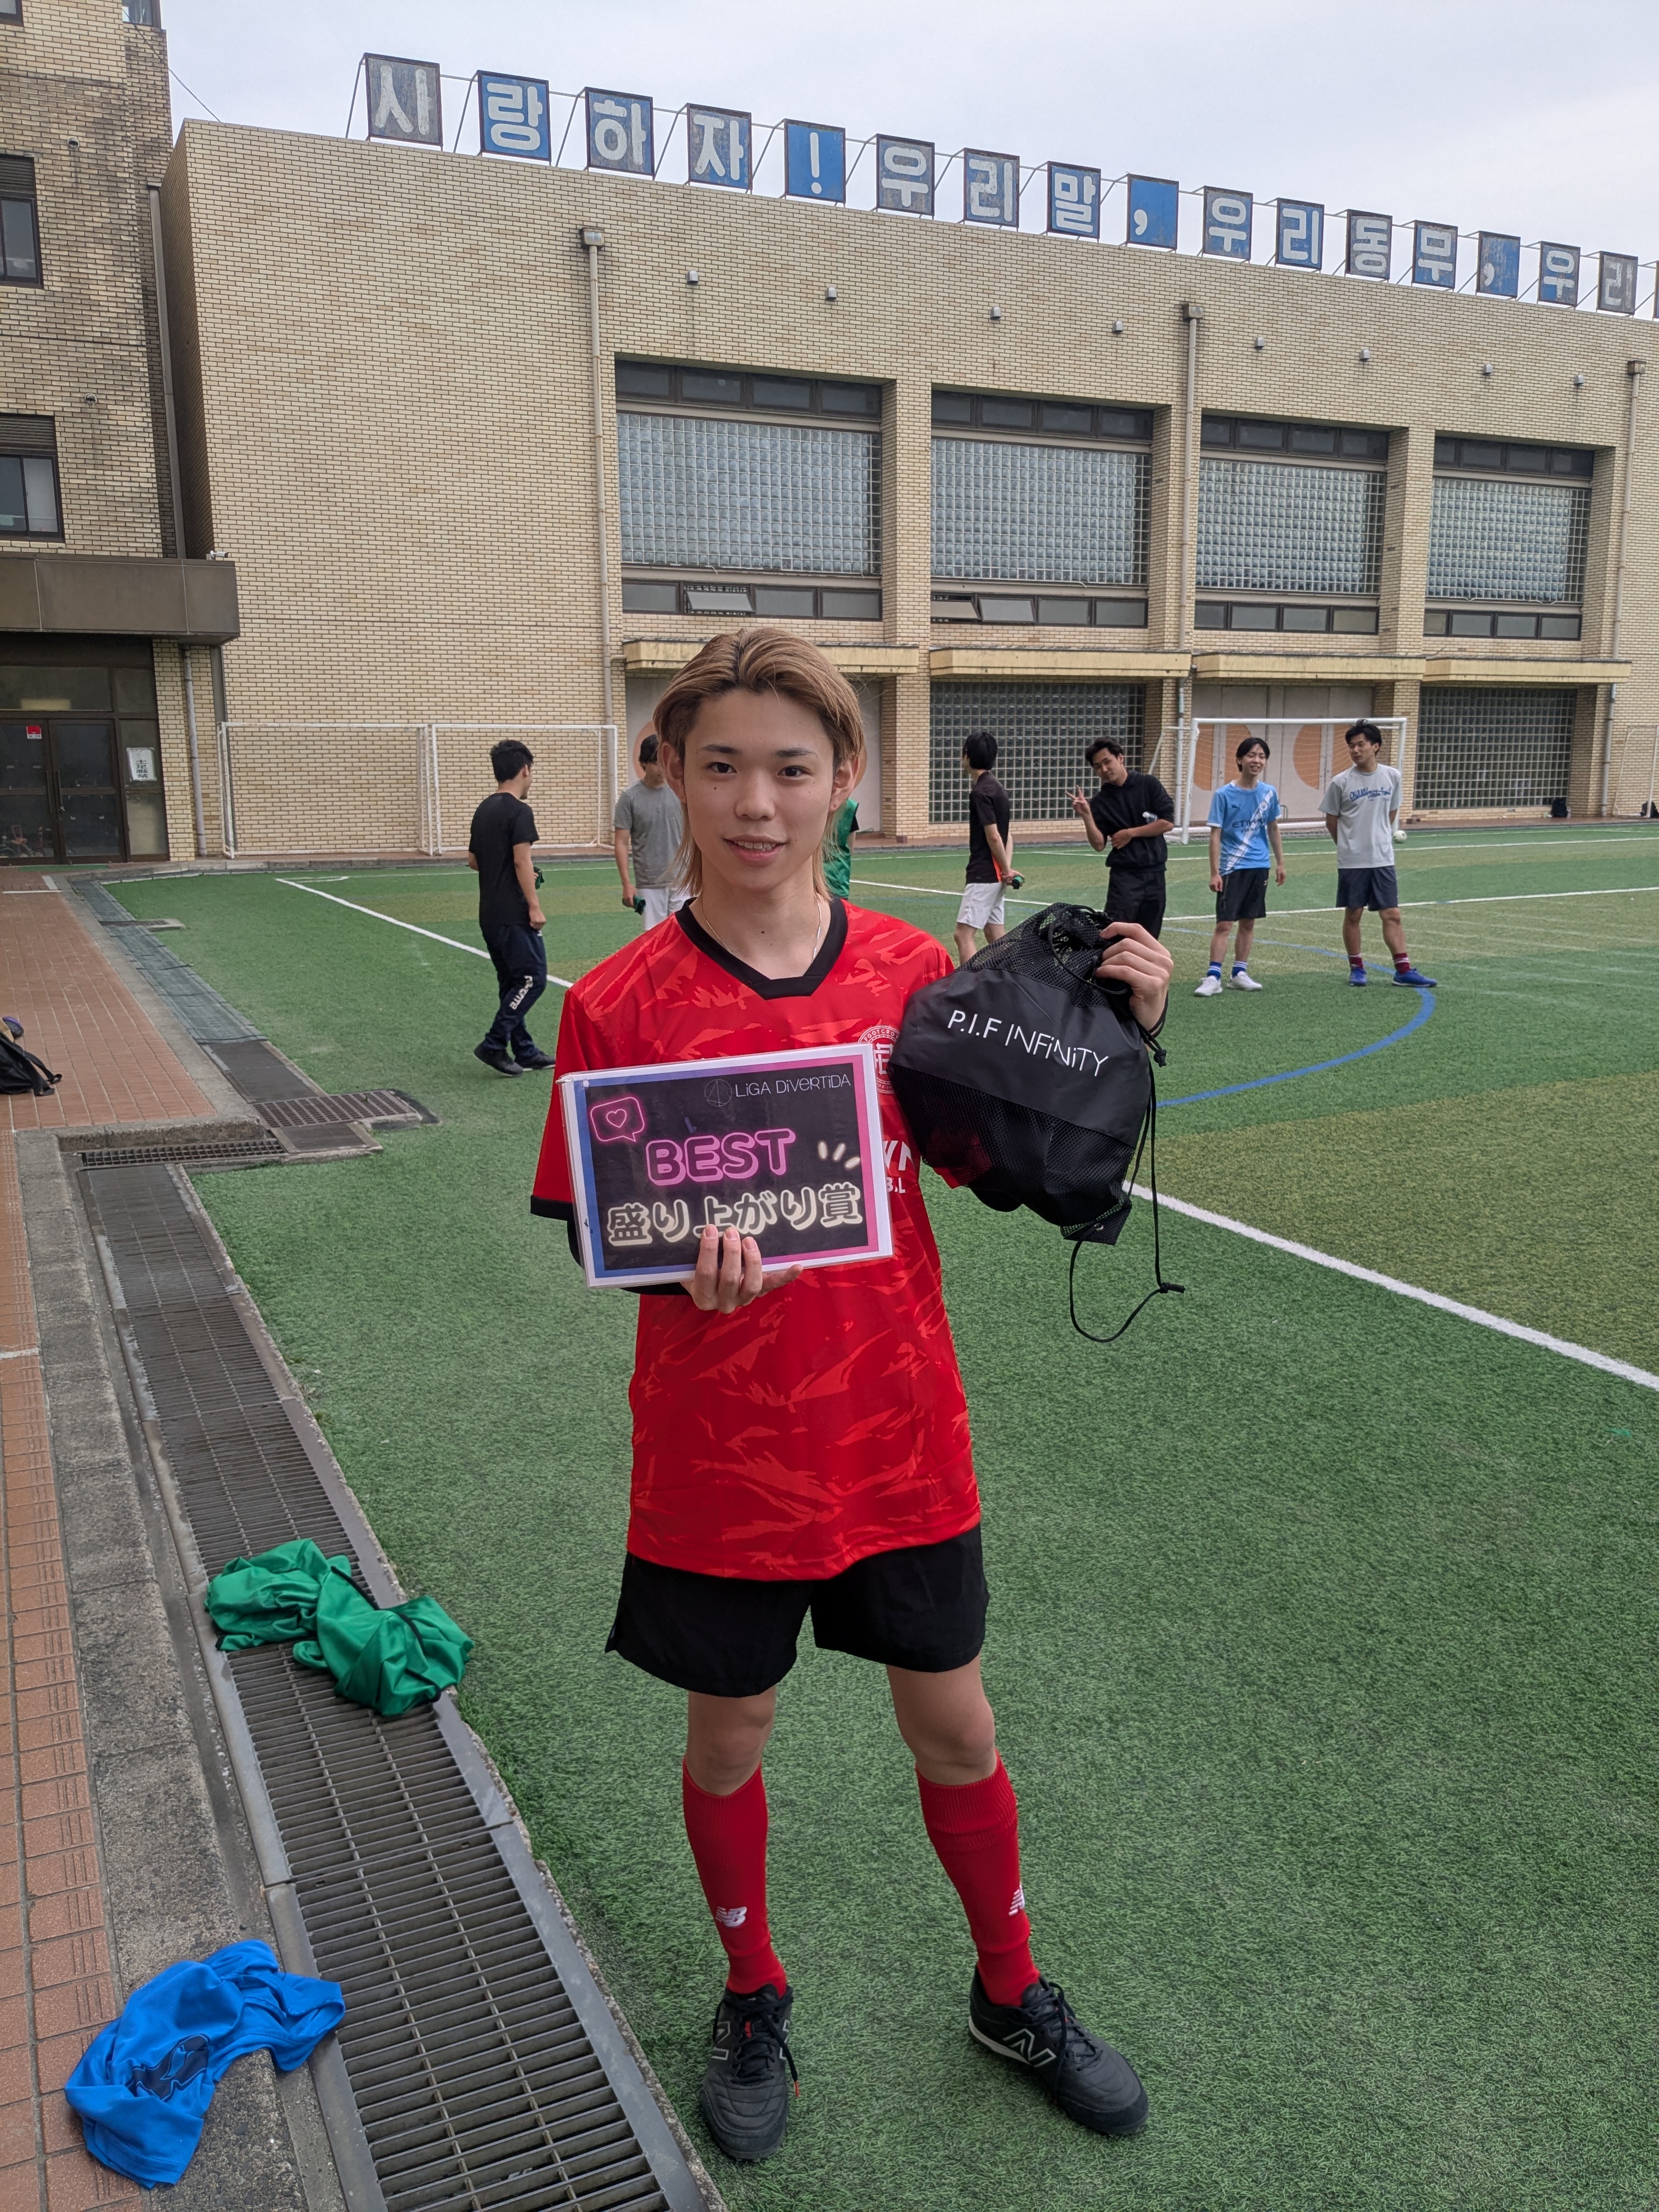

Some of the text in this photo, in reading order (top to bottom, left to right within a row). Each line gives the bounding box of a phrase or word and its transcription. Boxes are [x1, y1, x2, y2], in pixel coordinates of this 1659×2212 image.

[374, 65, 822, 194] 사랑하자!
[881, 146, 1148, 236] 우리말,
[1543, 250, 1633, 308] 우리
[947, 1009, 1002, 1039] P.I.F
[646, 1128, 796, 1186] BEST
[607, 1182, 863, 1246] 盛り上がり賞
